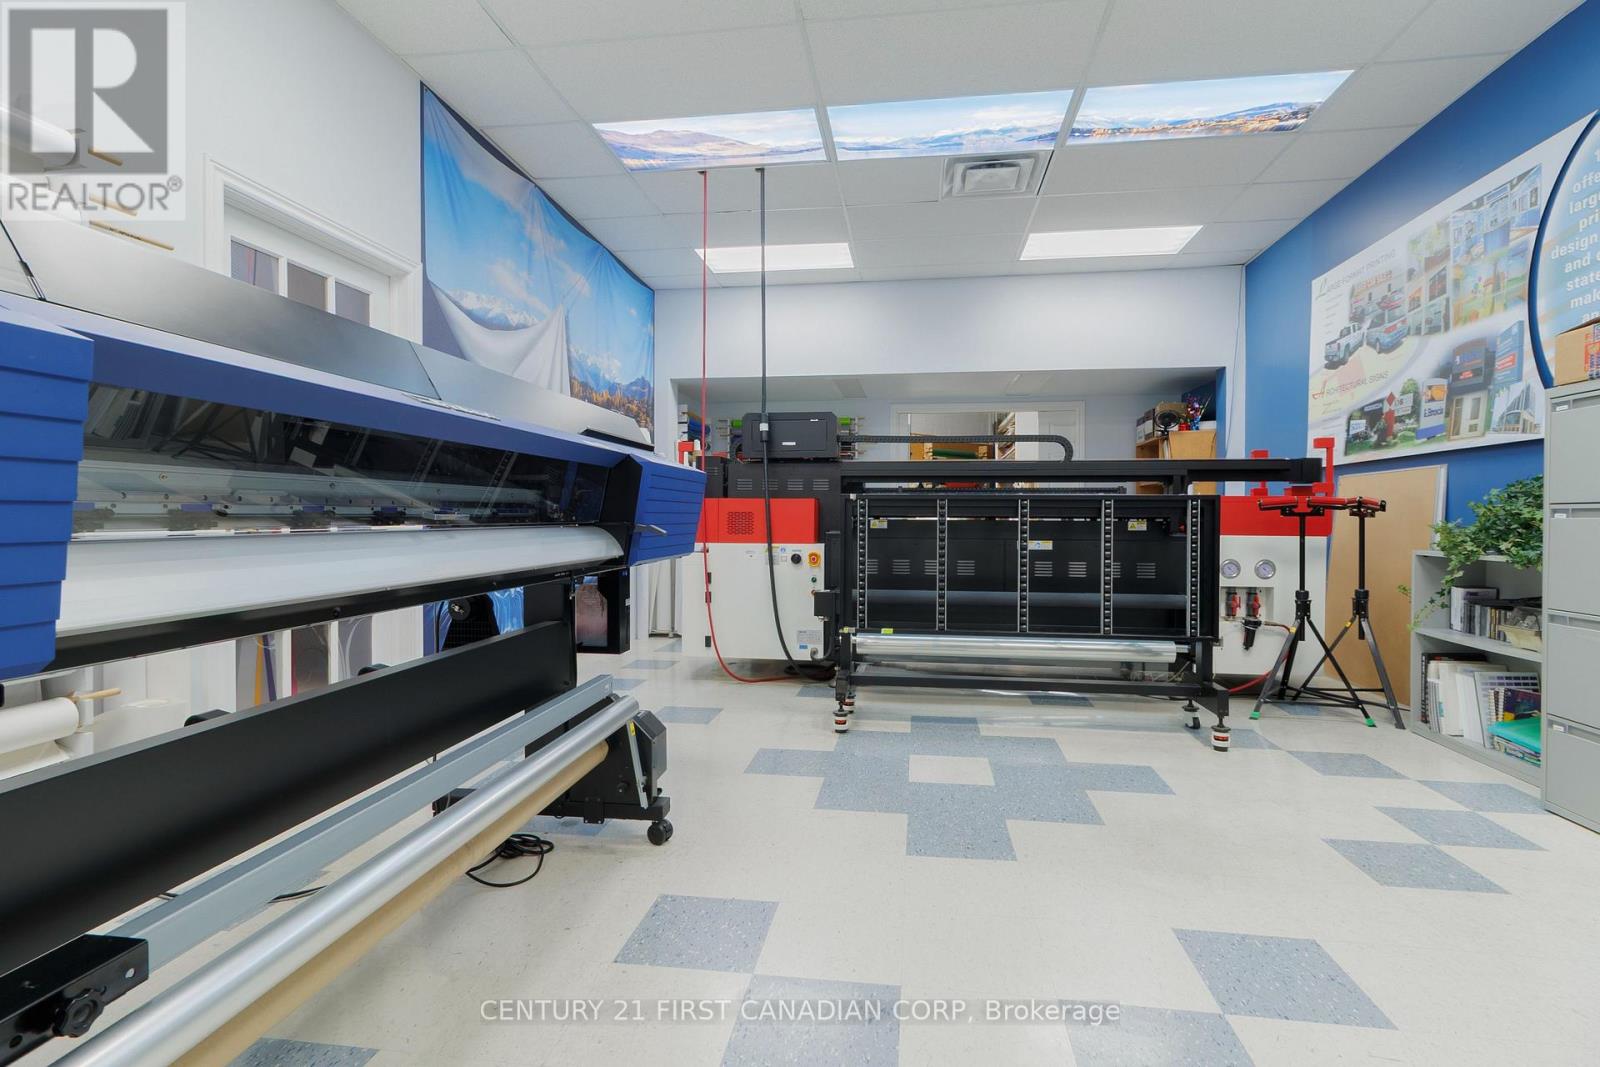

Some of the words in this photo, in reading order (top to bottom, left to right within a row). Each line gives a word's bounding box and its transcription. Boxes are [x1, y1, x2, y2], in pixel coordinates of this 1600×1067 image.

[1570, 192, 1600, 214] larg
[1551, 234, 1598, 259] design
[1565, 251, 1590, 273] and
